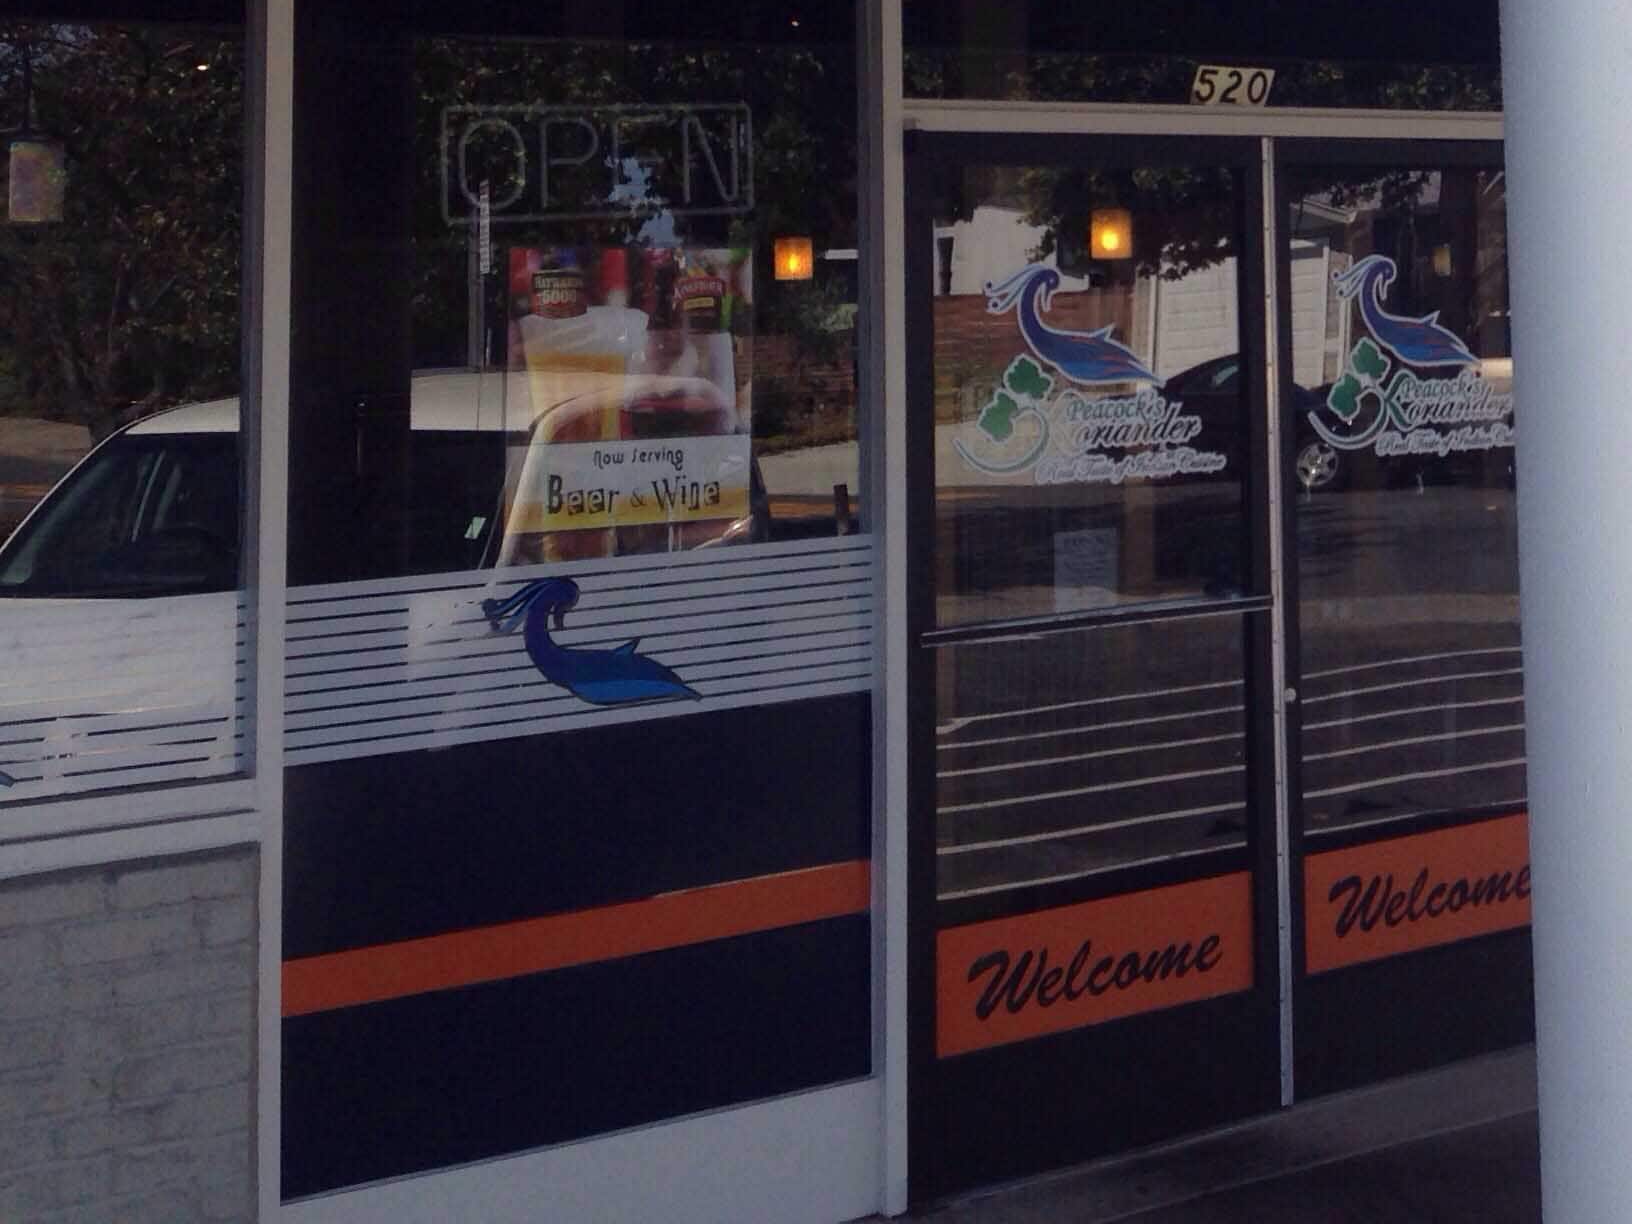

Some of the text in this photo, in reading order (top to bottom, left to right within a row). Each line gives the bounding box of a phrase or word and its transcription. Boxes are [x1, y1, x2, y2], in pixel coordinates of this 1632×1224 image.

[1193, 68, 1268, 105] 520
[457, 114, 740, 211] OPEN
[1067, 390, 1165, 421] Peacock's
[1400, 372, 1482, 403] Peacock's
[631, 447, 684, 472] Serving
[547, 474, 721, 516] Beer & Wine
[1327, 863, 1533, 939] Welcome
[966, 932, 1224, 1022] Welcome
